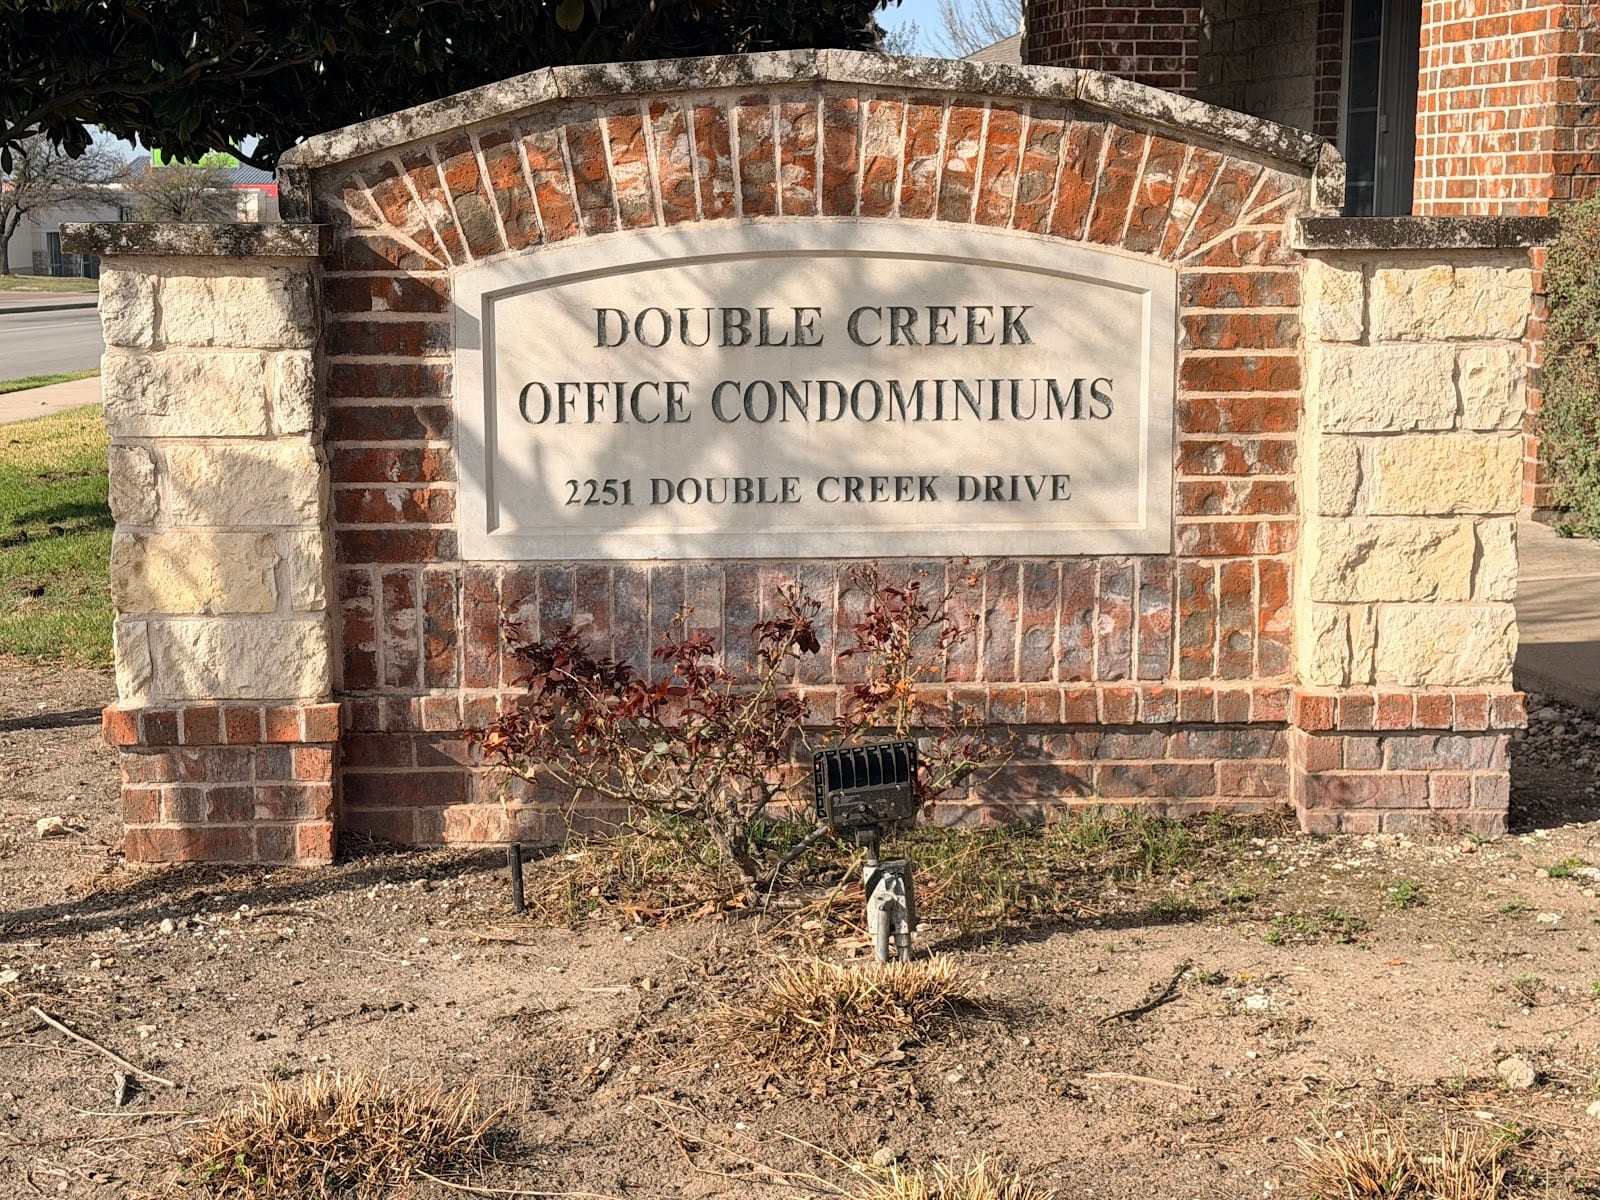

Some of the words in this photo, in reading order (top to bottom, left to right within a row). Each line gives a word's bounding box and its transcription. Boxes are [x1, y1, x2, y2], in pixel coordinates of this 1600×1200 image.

[593, 306, 823, 349] DOUBLE
[847, 305, 1035, 346] CREEK
[519, 380, 692, 424] OFFICE
[711, 377, 1114, 423] CONDOMINIUMS
[565, 479, 635, 506] 2251
[650, 476, 800, 505] DOUBLE
[816, 475, 939, 503] CREEK
[958, 474, 1072, 502] DRIVE
